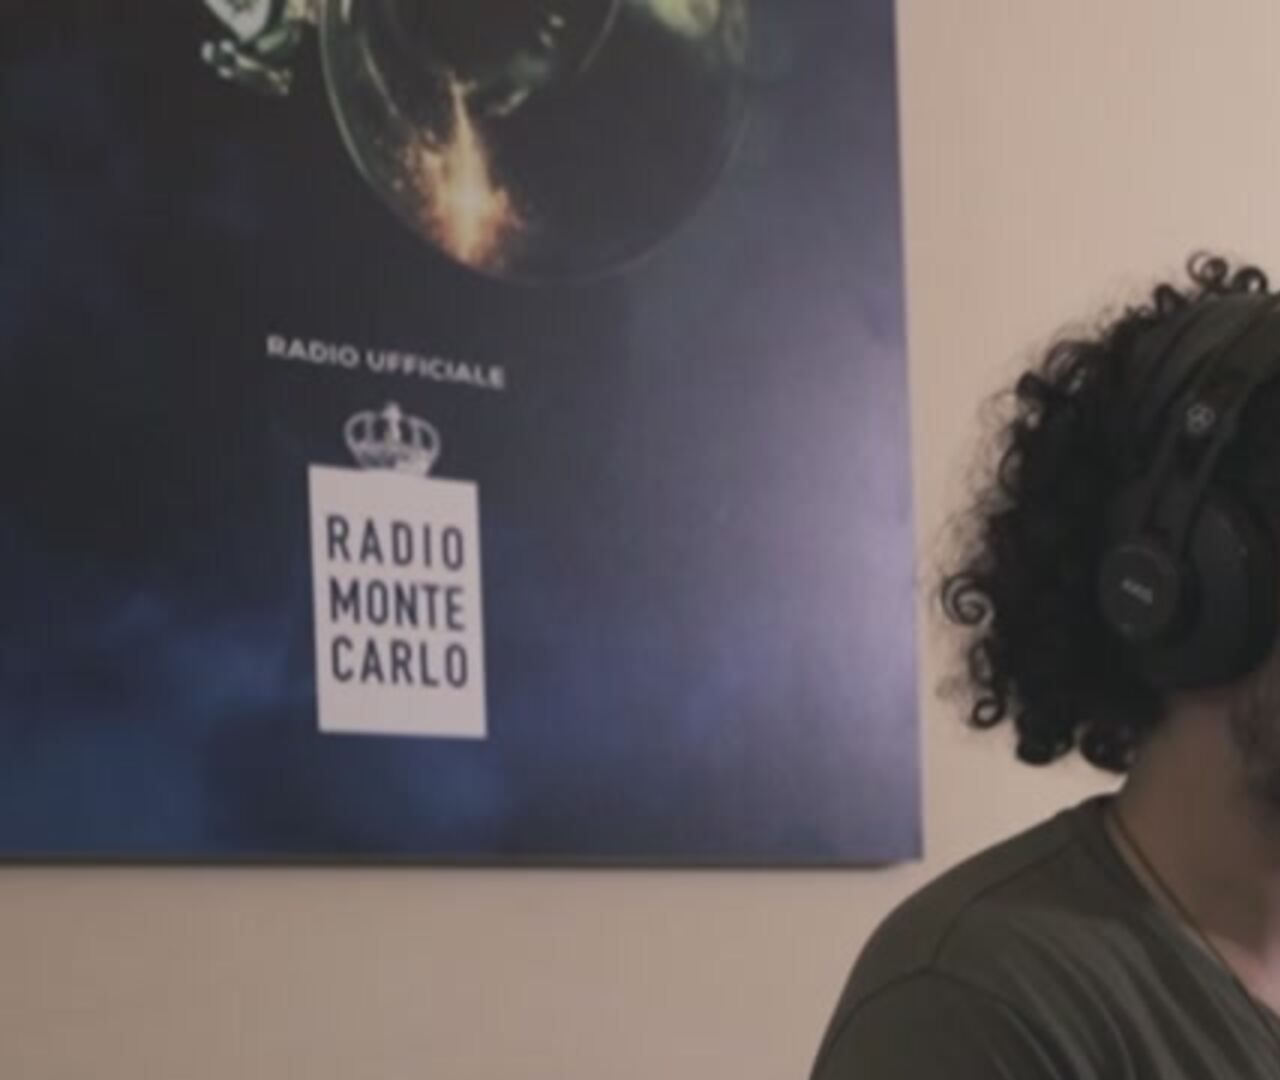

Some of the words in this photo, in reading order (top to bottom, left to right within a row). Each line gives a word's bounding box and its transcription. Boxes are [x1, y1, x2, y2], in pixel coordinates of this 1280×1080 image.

[266, 335, 360, 369] RADIO
[366, 352, 505, 390] UFFICIALE
[326, 514, 465, 571] RADIO
[329, 576, 466, 632] MONTE
[331, 636, 469, 689] CARLO
